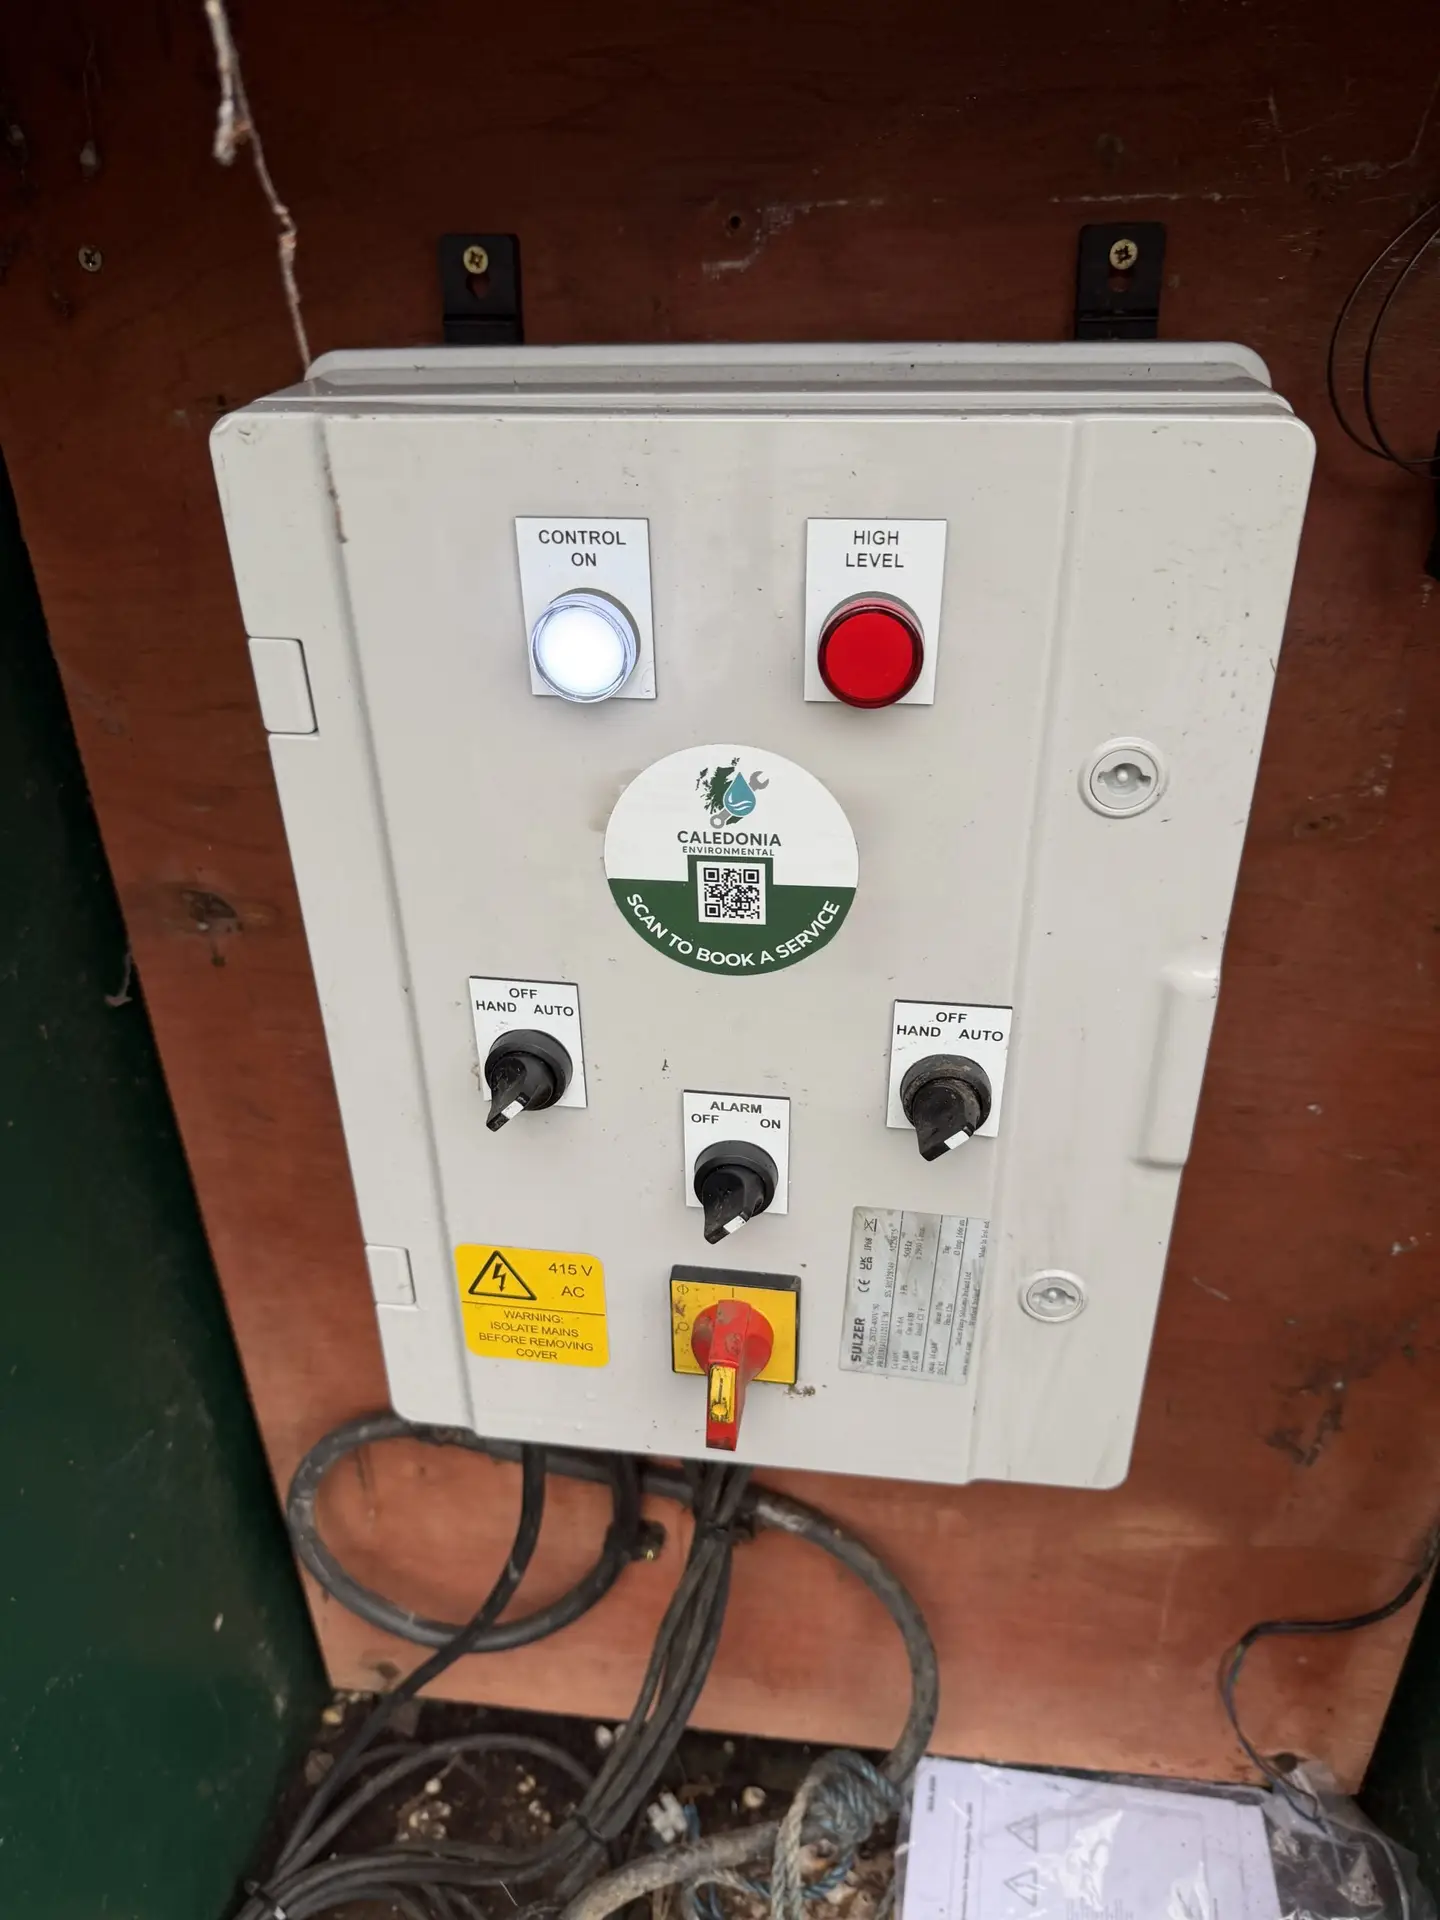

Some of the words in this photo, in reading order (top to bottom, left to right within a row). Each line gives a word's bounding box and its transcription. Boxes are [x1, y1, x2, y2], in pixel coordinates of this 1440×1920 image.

[538, 529, 627, 545] CONTROL
[853, 530, 899, 545] HIGH
[571, 552, 597, 567] ON
[845, 552, 905, 568] LEVEL
[677, 830, 782, 847] CALEDONIA
[682, 846, 775, 857] ENVIRONMENTAL
[626, 893, 668, 939] SCAN
[668, 933, 693, 955] TO
[696, 947, 755, 967] BOOK
[760, 950, 775, 964] A
[775, 900, 840, 958] SERVICE
[508, 987, 538, 1000] OFF
[475, 1000, 517, 1013] HAND
[533, 1004, 574, 1017] AUTO
[935, 1011, 968, 1024] OFF
[896, 1024, 942, 1038] HAND
[958, 1029, 1004, 1042] AUTO
[709, 1100, 762, 1115] ALARM
[691, 1113, 719, 1125] OFF
[760, 1118, 781, 1130] ON
[864, 1236, 874, 1252] IP68
[903, 1240, 914, 1258] 50Hz
[548, 1263, 577, 1276] 415
[581, 1265, 593, 1276] V
[860, 1256, 868, 1270] UK
[866, 1256, 874, 1270] CA
[561, 1285, 585, 1298] AC
[503, 1309, 564, 1324] WARNING:
[490, 1321, 538, 1334] ISOLATE
[541, 1326, 579, 1338] MAINS
[479, 1332, 526, 1345] BEFORE
[529, 1337, 593, 1352] REMOVING
[851, 1317, 866, 1362] SULZER
[516, 1347, 558, 1360] COVER
